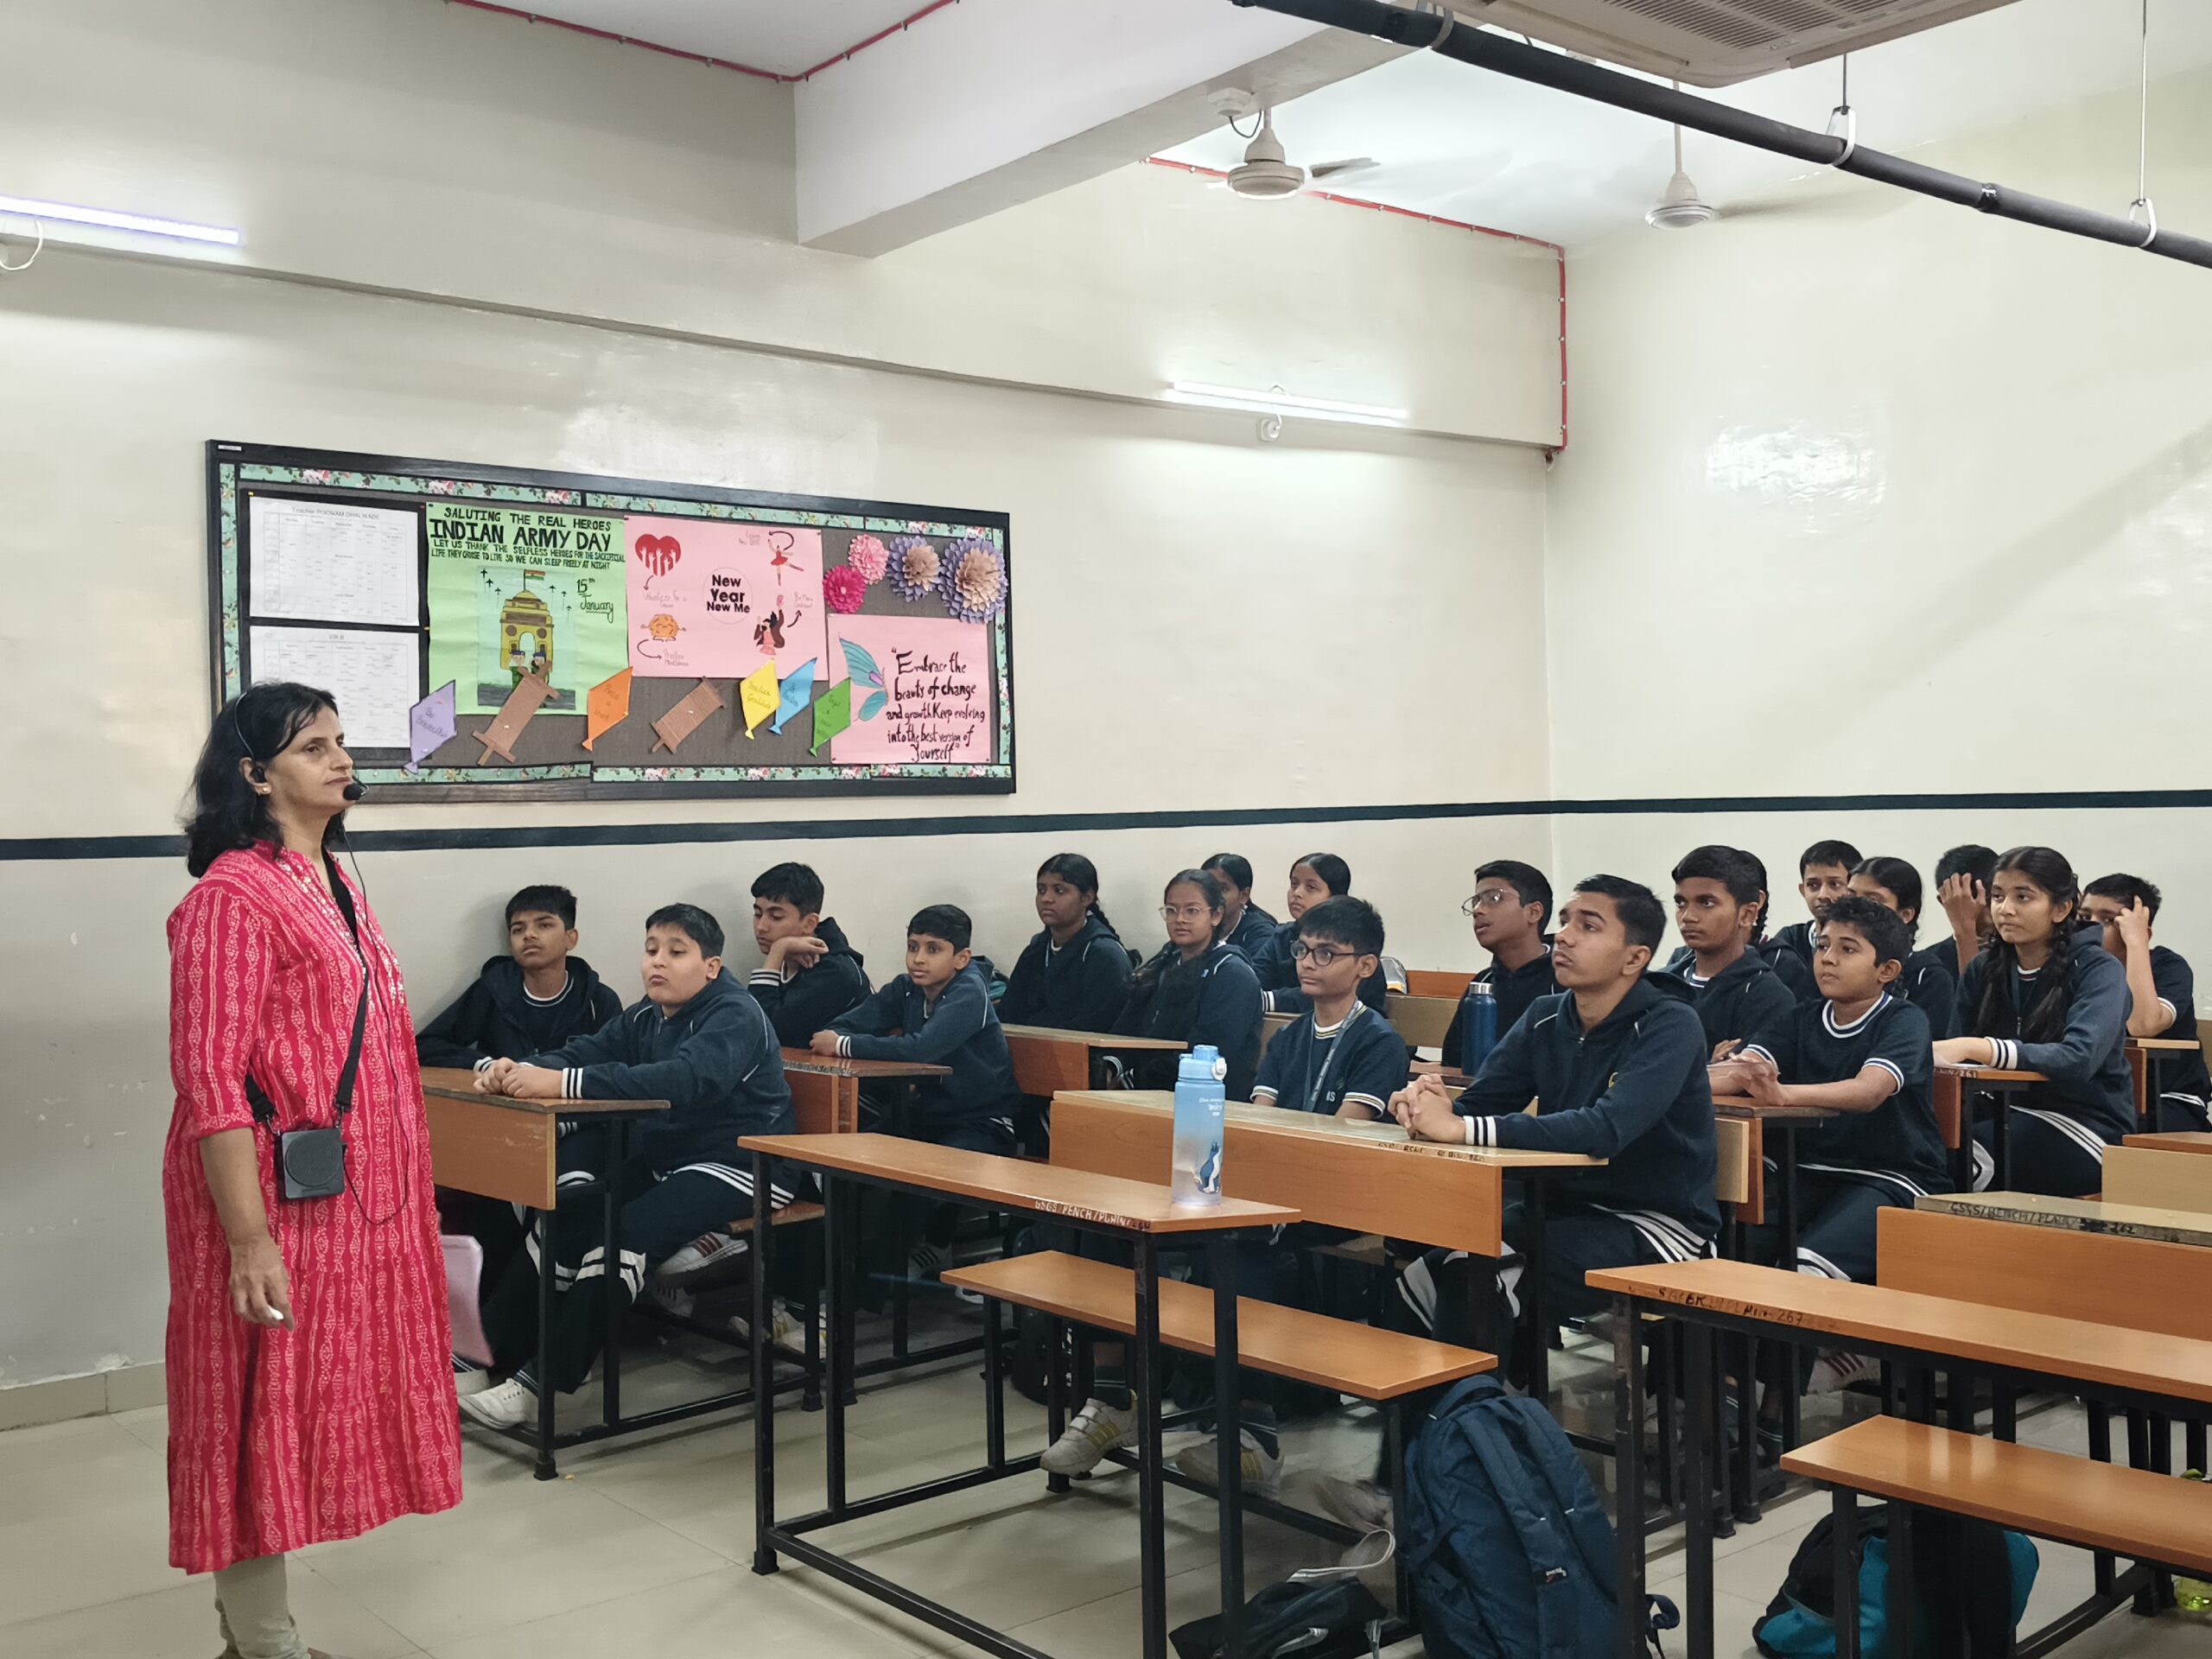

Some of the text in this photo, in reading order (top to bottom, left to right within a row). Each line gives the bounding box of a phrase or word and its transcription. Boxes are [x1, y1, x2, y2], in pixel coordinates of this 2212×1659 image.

[443, 506, 612, 531] SALUTING THE REAL HEROES
[429, 518, 611, 552] INDIAN ARMY DAY
[431, 549, 445, 557] LIFE
[448, 549, 461, 559] THEY
[490, 552, 503, 562] LIVE
[516, 555, 526, 564] WE
[530, 556, 542, 565] CAN
[543, 557, 562, 567] SLEEP
[591, 561, 610, 570] NIGHT
[466, 542, 488, 551] THANK
[493, 543, 507, 552] THE
[513, 545, 548, 557] SELFLESS
[712, 574, 741, 588] New
[710, 588, 745, 602] Year
[707, 601, 751, 613] New Me
[949, 651, 967, 674] the
[894, 675, 976, 702] beauty of change
[886, 701, 985, 725] and growth Keep evolving
[920, 722, 938, 743] best
[938, 731, 961, 743] version
[963, 724, 975, 747] of
